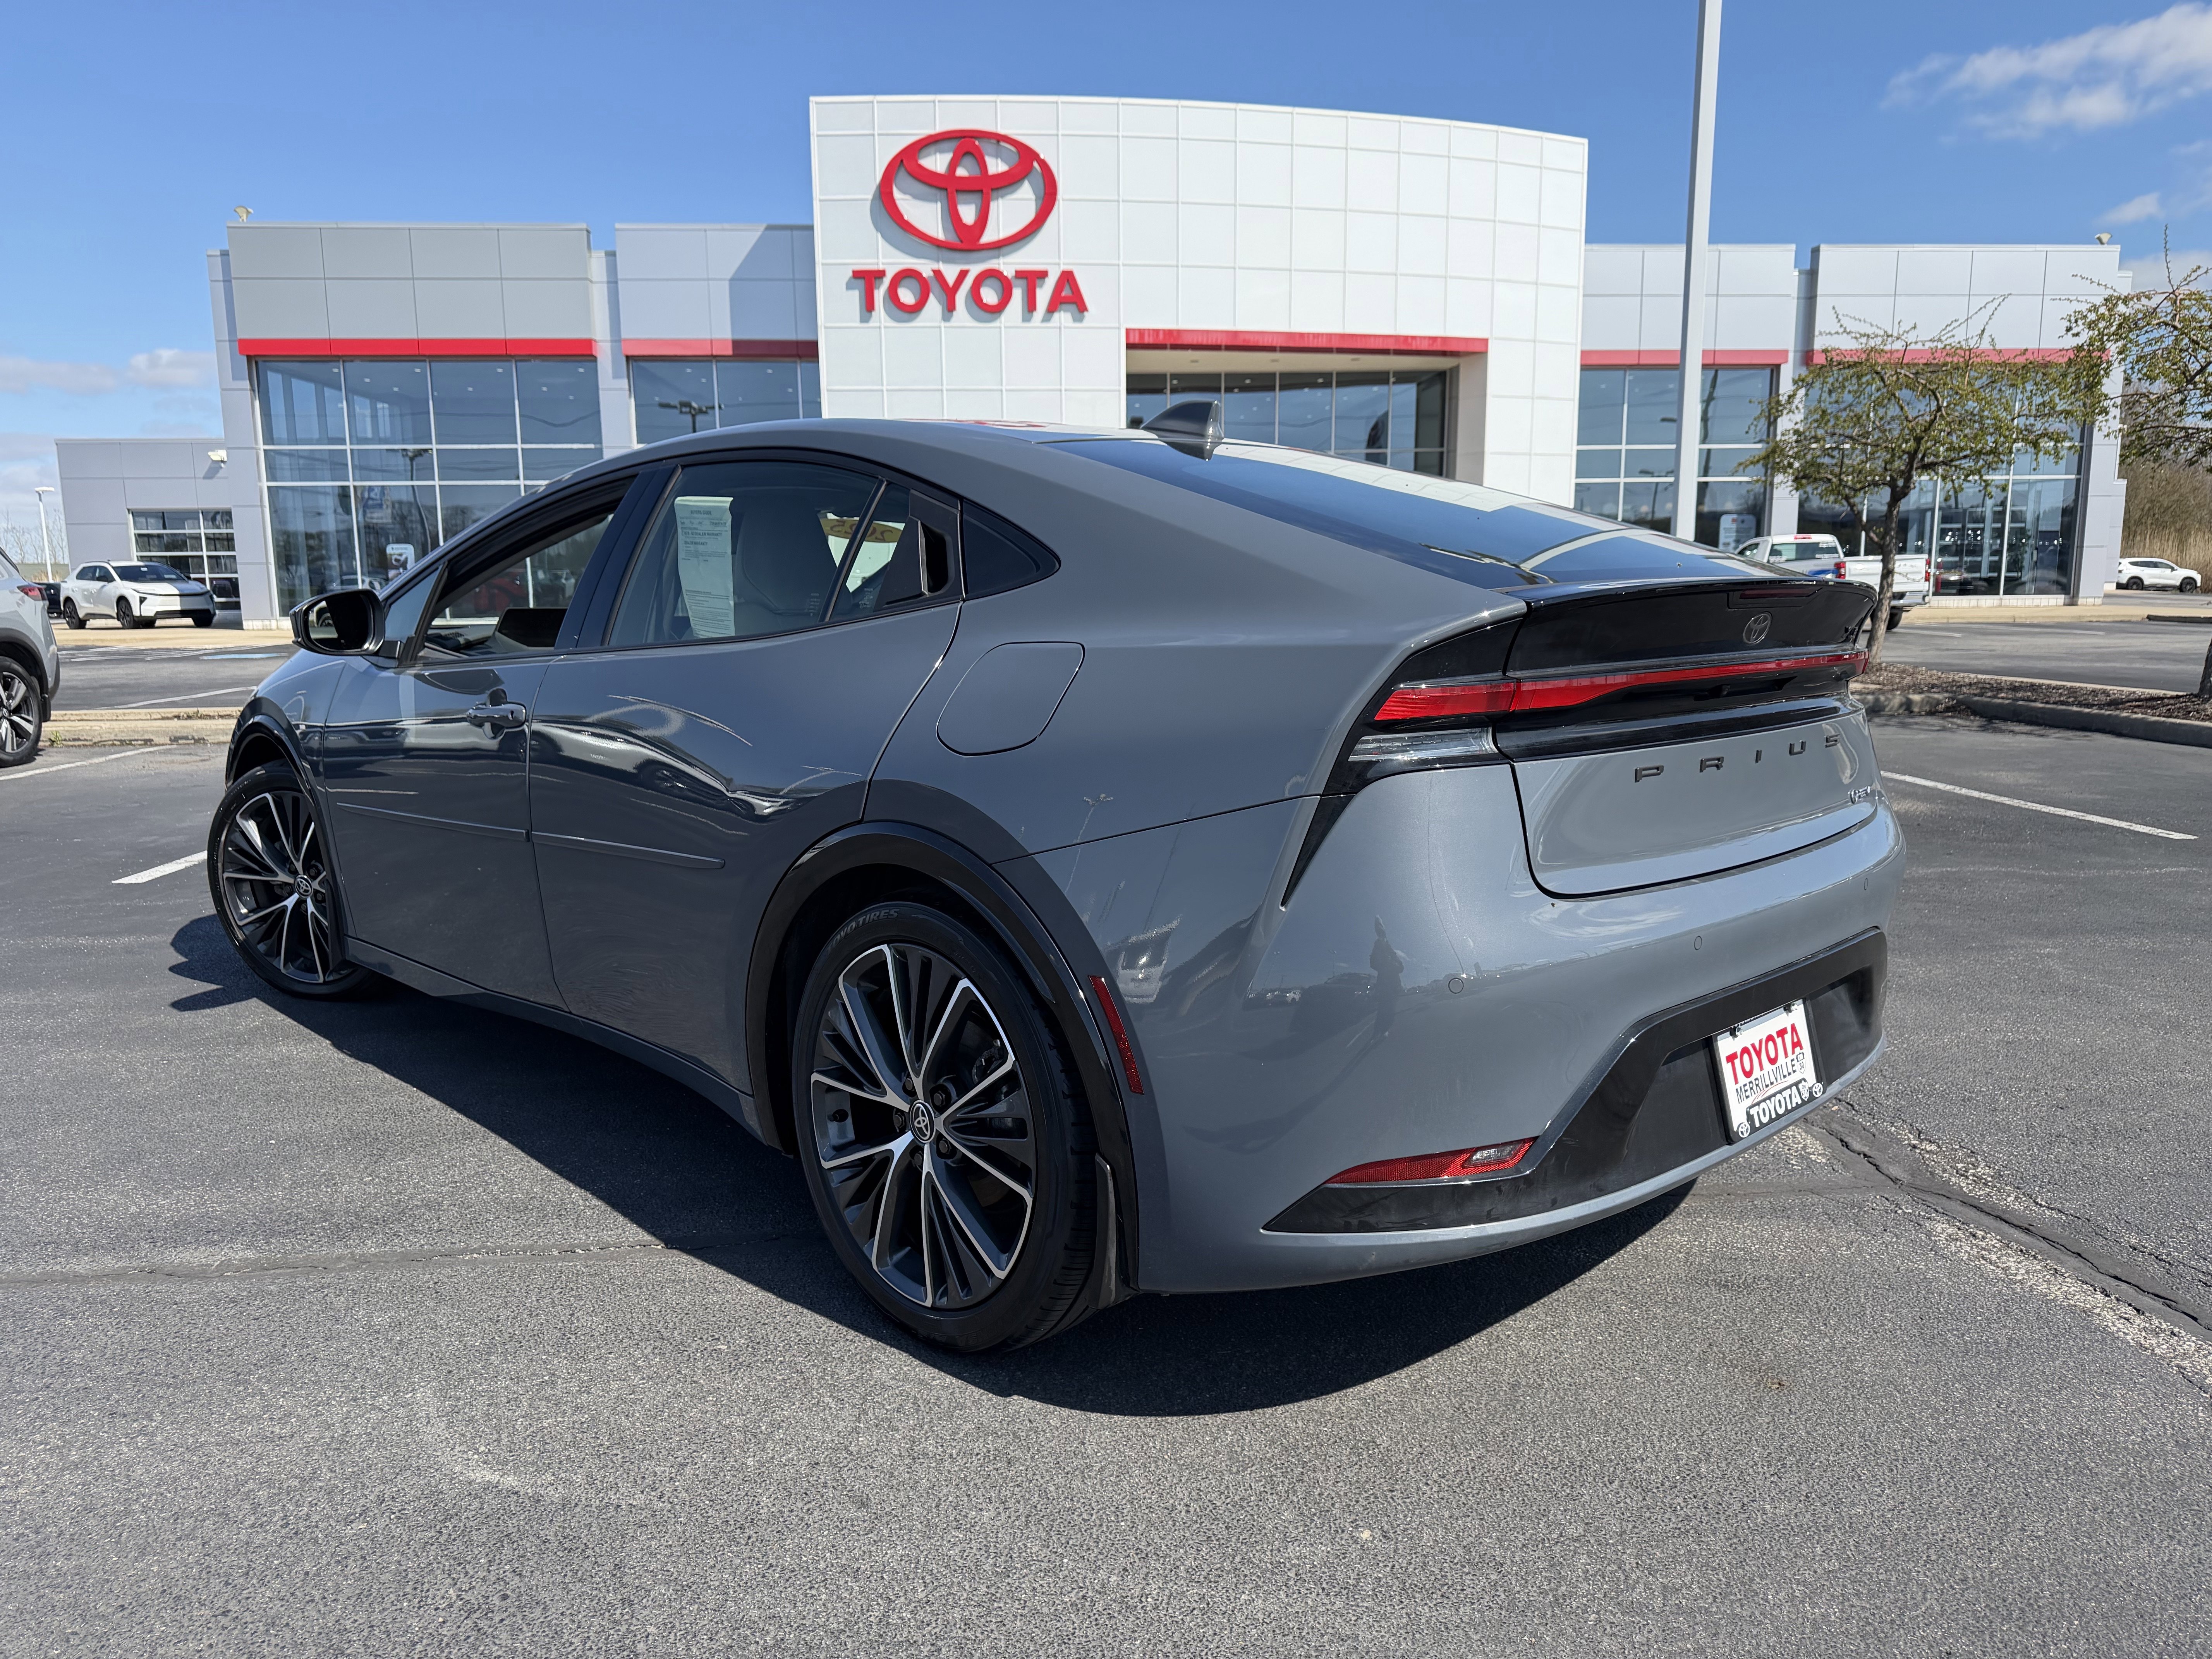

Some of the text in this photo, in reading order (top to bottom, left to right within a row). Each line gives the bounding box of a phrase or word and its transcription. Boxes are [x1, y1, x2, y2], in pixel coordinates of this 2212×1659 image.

[852, 268, 1089, 313] TOYOTA
[1635, 733, 1840, 783] PRIUS
[858, 908, 900, 927] TIRES
[1726, 1023, 1803, 1085] TOYOTA
[1736, 1058, 1797, 1104] MERRILLVILLE
[1750, 1085, 1802, 1127] TOYOTA
